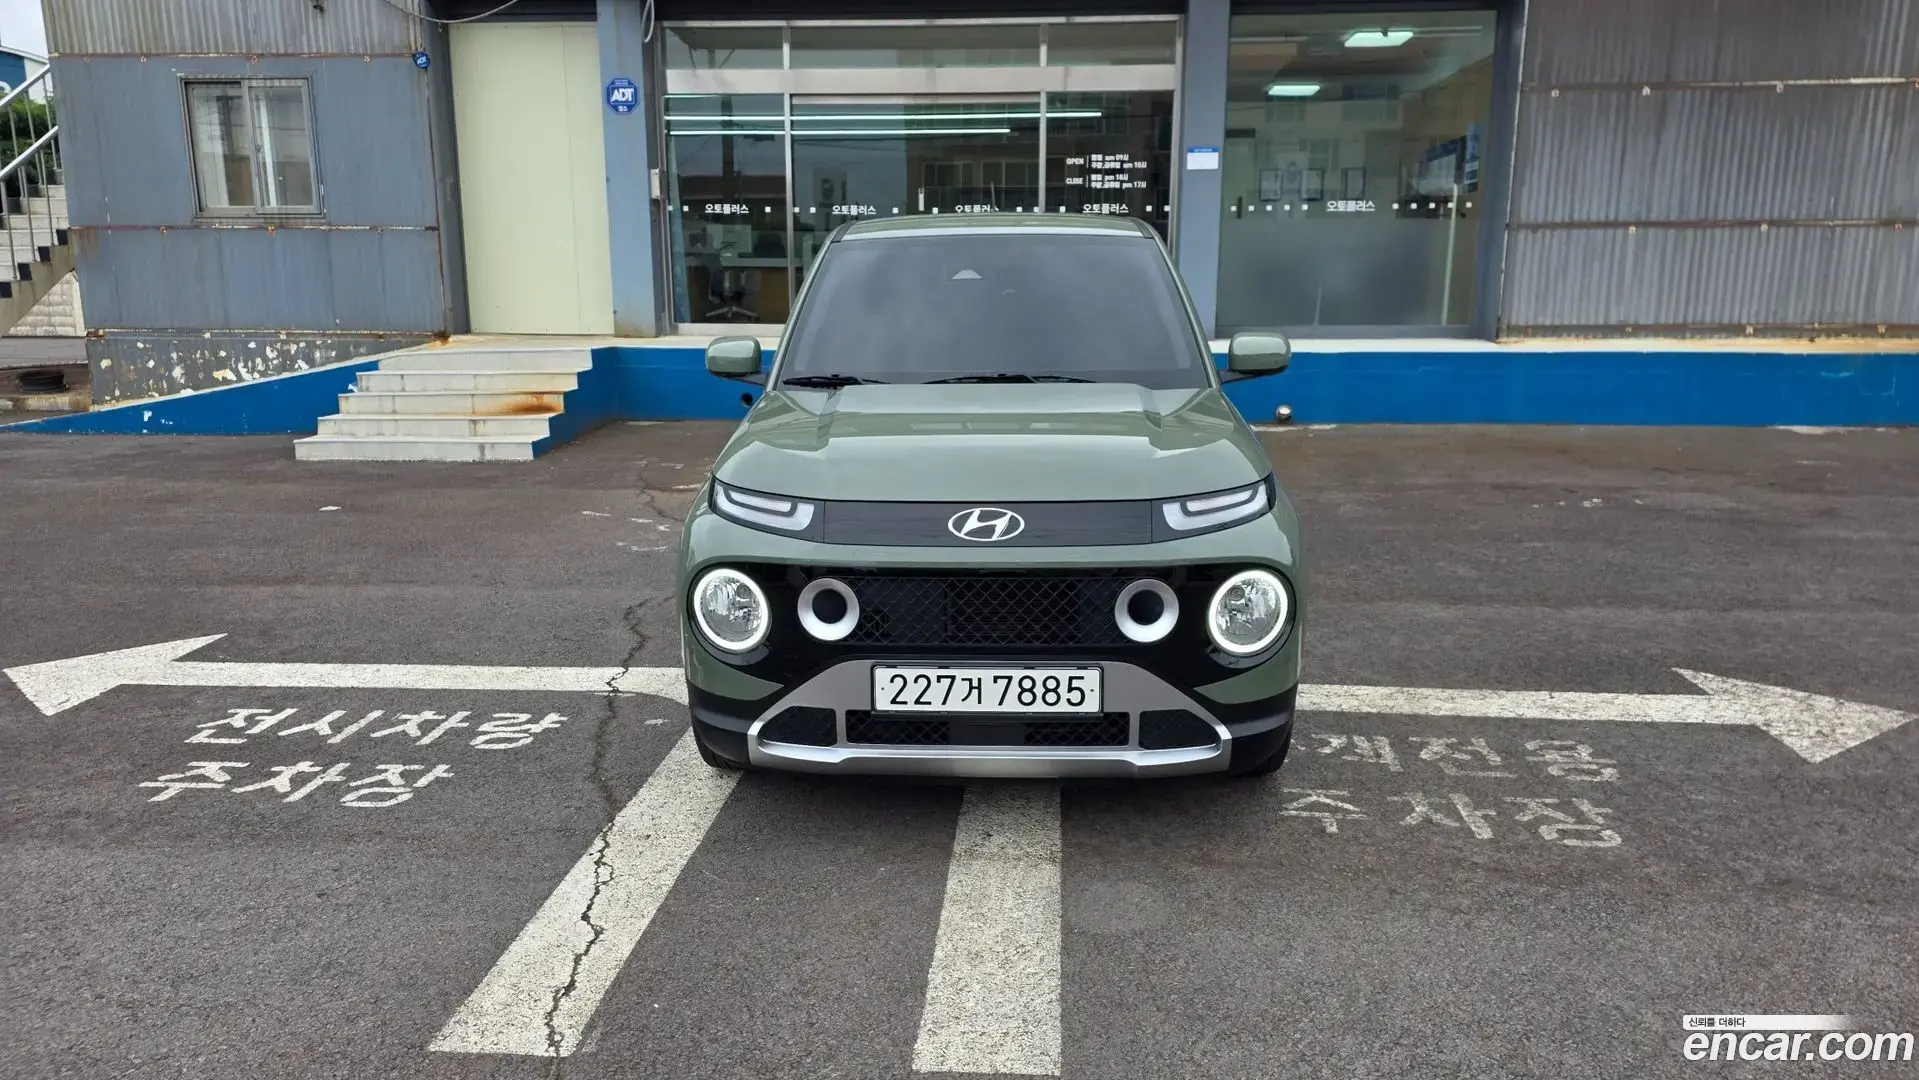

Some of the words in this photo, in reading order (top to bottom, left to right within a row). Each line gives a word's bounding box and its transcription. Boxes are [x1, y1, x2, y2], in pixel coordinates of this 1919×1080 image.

[611, 88, 635, 102] ADT
[1066, 157, 1085, 165] OPEN
[705, 203, 750, 215] 오토플러스
[832, 204, 877, 216] 오토플러스
[1082, 203, 1129, 214] 오토플러스
[1326, 200, 1376, 212] 오토플러스
[889, 674, 983, 706] 227거
[993, 675, 1086, 707] 7885
[184, 707, 569, 750] 전시차량
[1285, 733, 1620, 783] 객전용
[138, 761, 455, 808] 주차장
